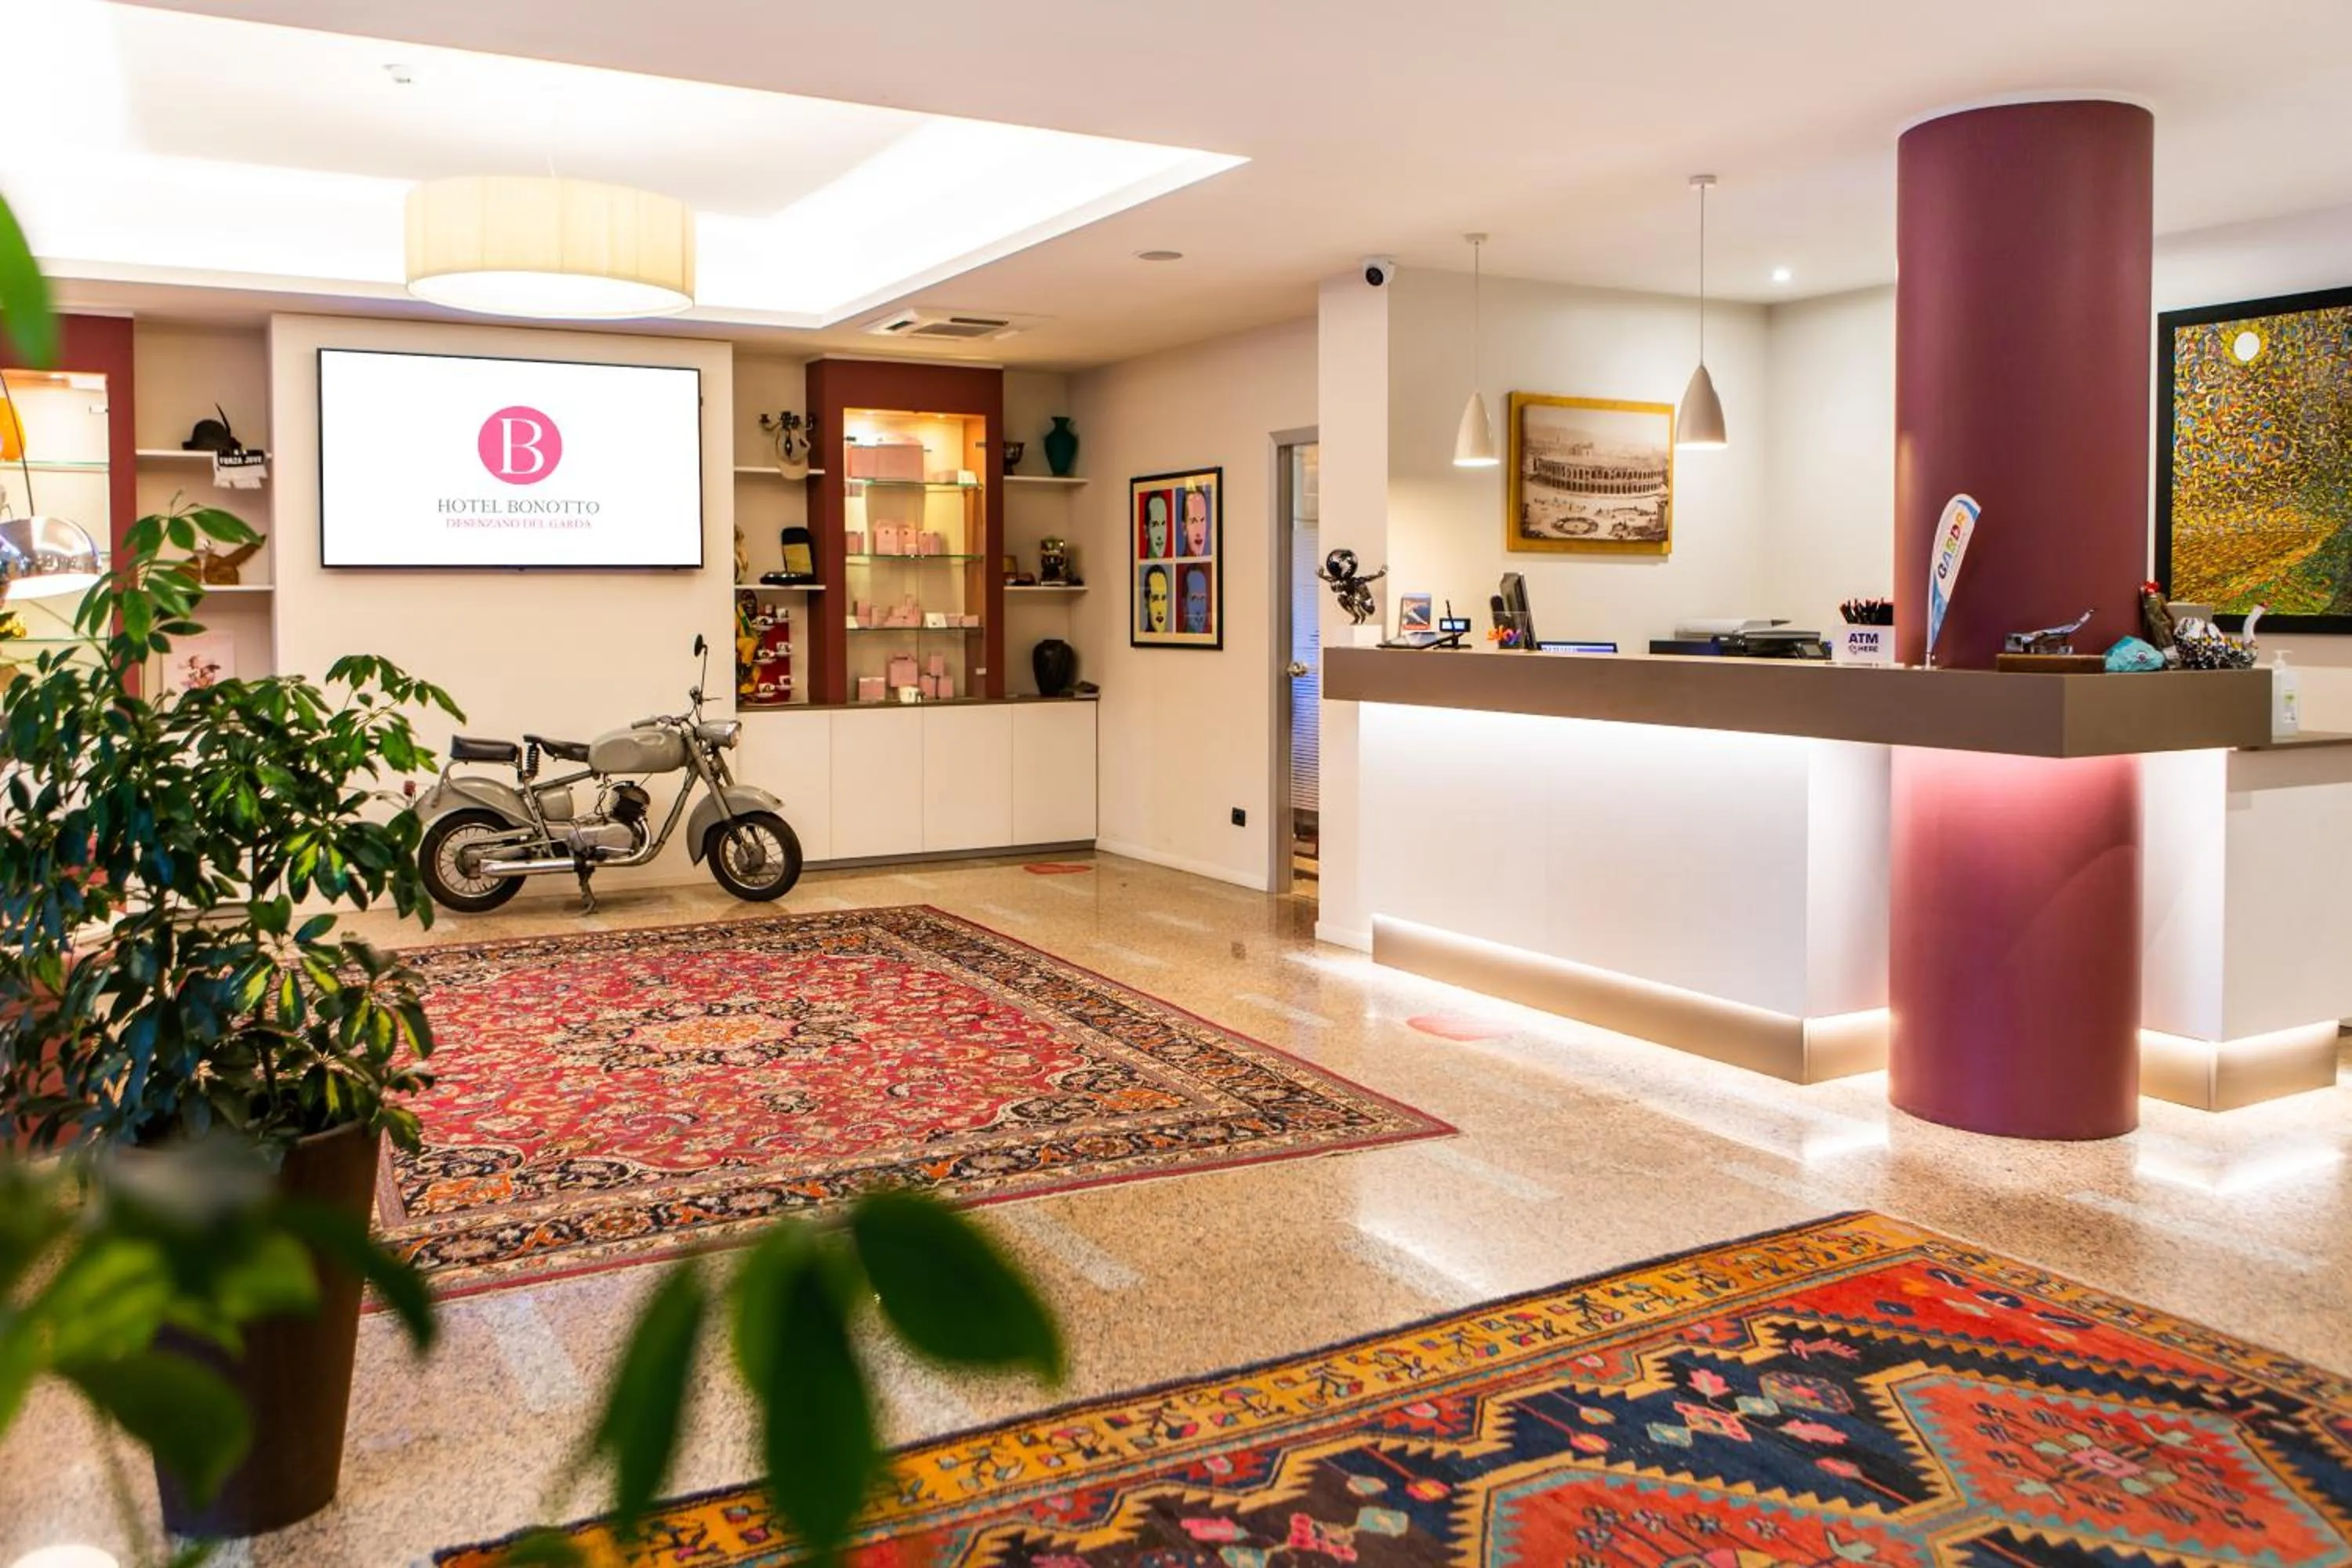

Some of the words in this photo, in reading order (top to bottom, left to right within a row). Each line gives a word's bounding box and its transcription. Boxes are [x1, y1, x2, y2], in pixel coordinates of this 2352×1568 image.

[499, 418, 545, 475] B
[438, 499, 502, 514] HOTEL
[507, 499, 600, 514] BONOTTO
[446, 518, 520, 529] DESENZANO
[523, 519, 545, 529] DEL
[549, 519, 592, 529] GARDA
[1487, 625, 1522, 645] sky
[1848, 633, 1879, 644] ATM
